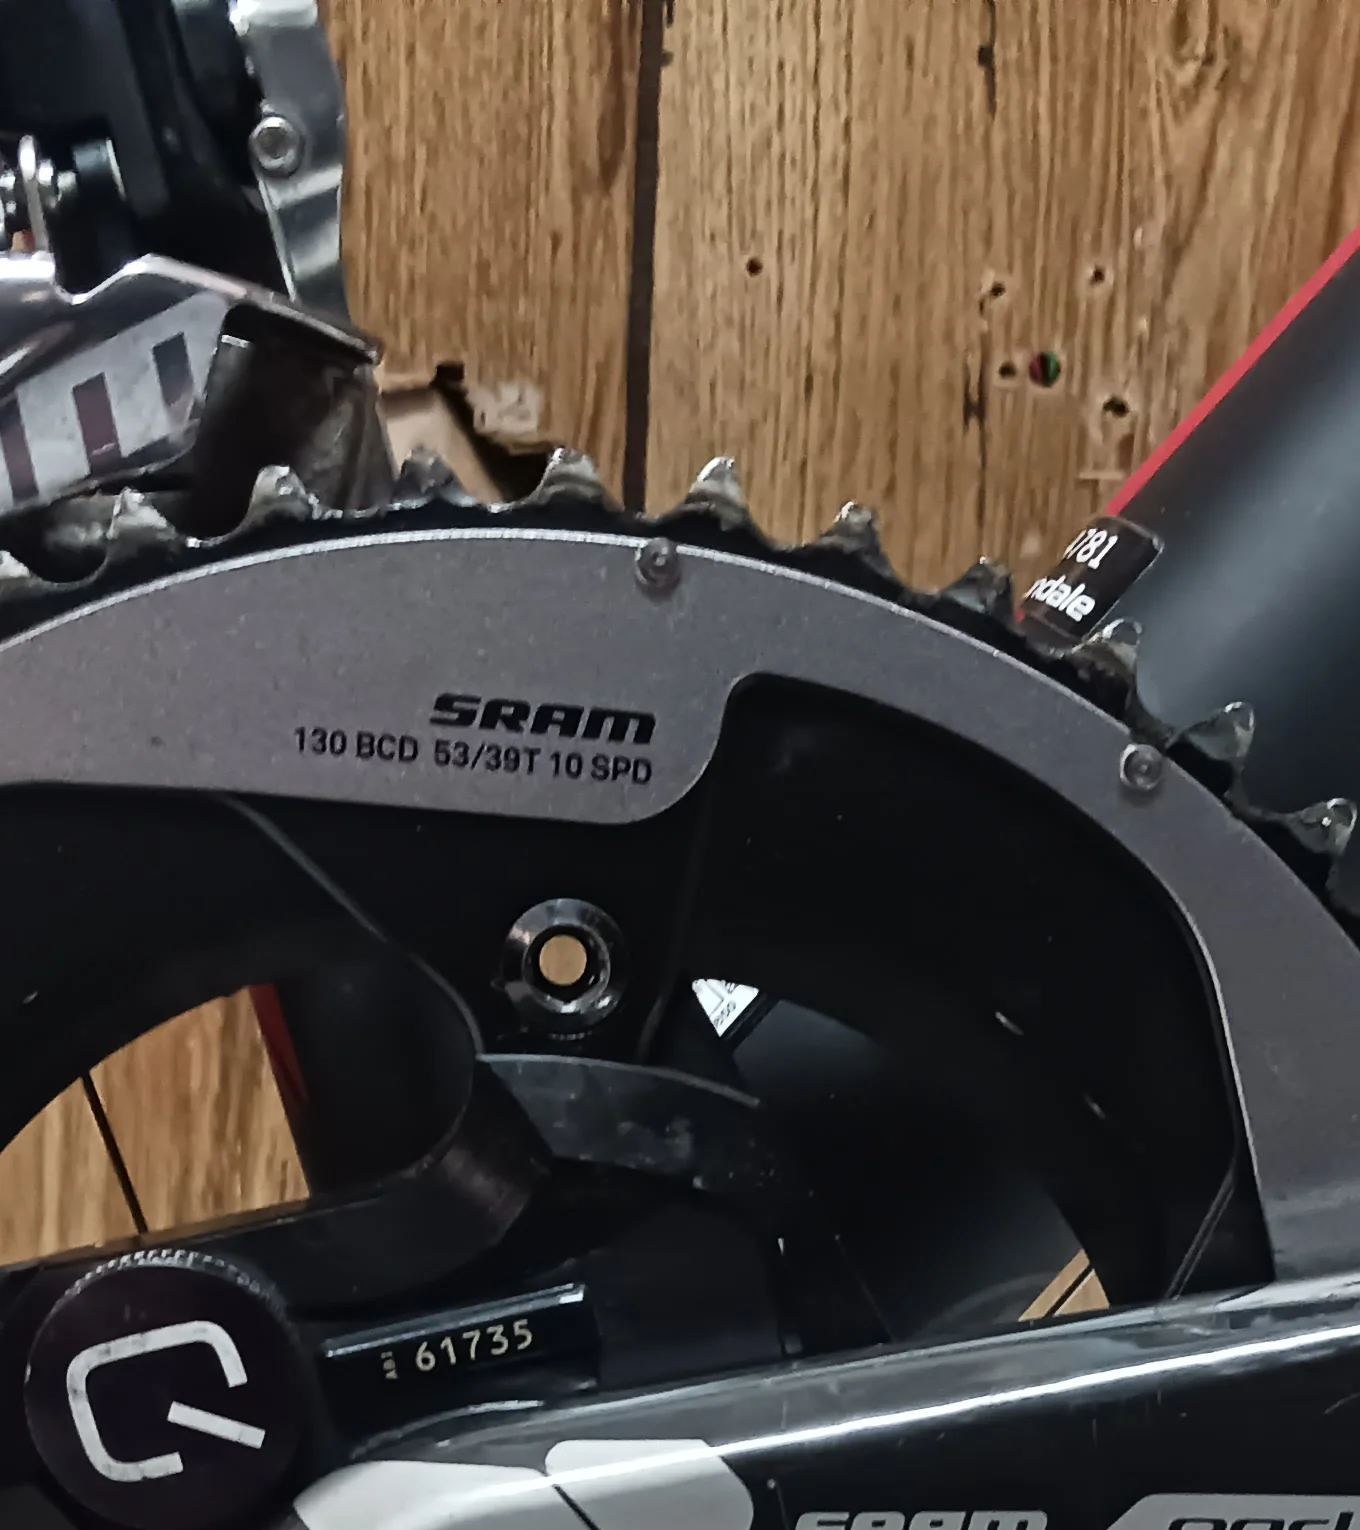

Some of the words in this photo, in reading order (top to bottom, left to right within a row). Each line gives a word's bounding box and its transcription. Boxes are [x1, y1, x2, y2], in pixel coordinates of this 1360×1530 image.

[429, 693, 657, 746] SRAM
[293, 725, 345, 756] 130
[356, 732, 419, 764] BCD
[433, 739, 541, 777] 53/39T
[550, 753, 584, 780] 10
[590, 757, 653, 786] SPD
[415, 1318, 533, 1372] 61735
[66, 1320, 266, 1482] Q
